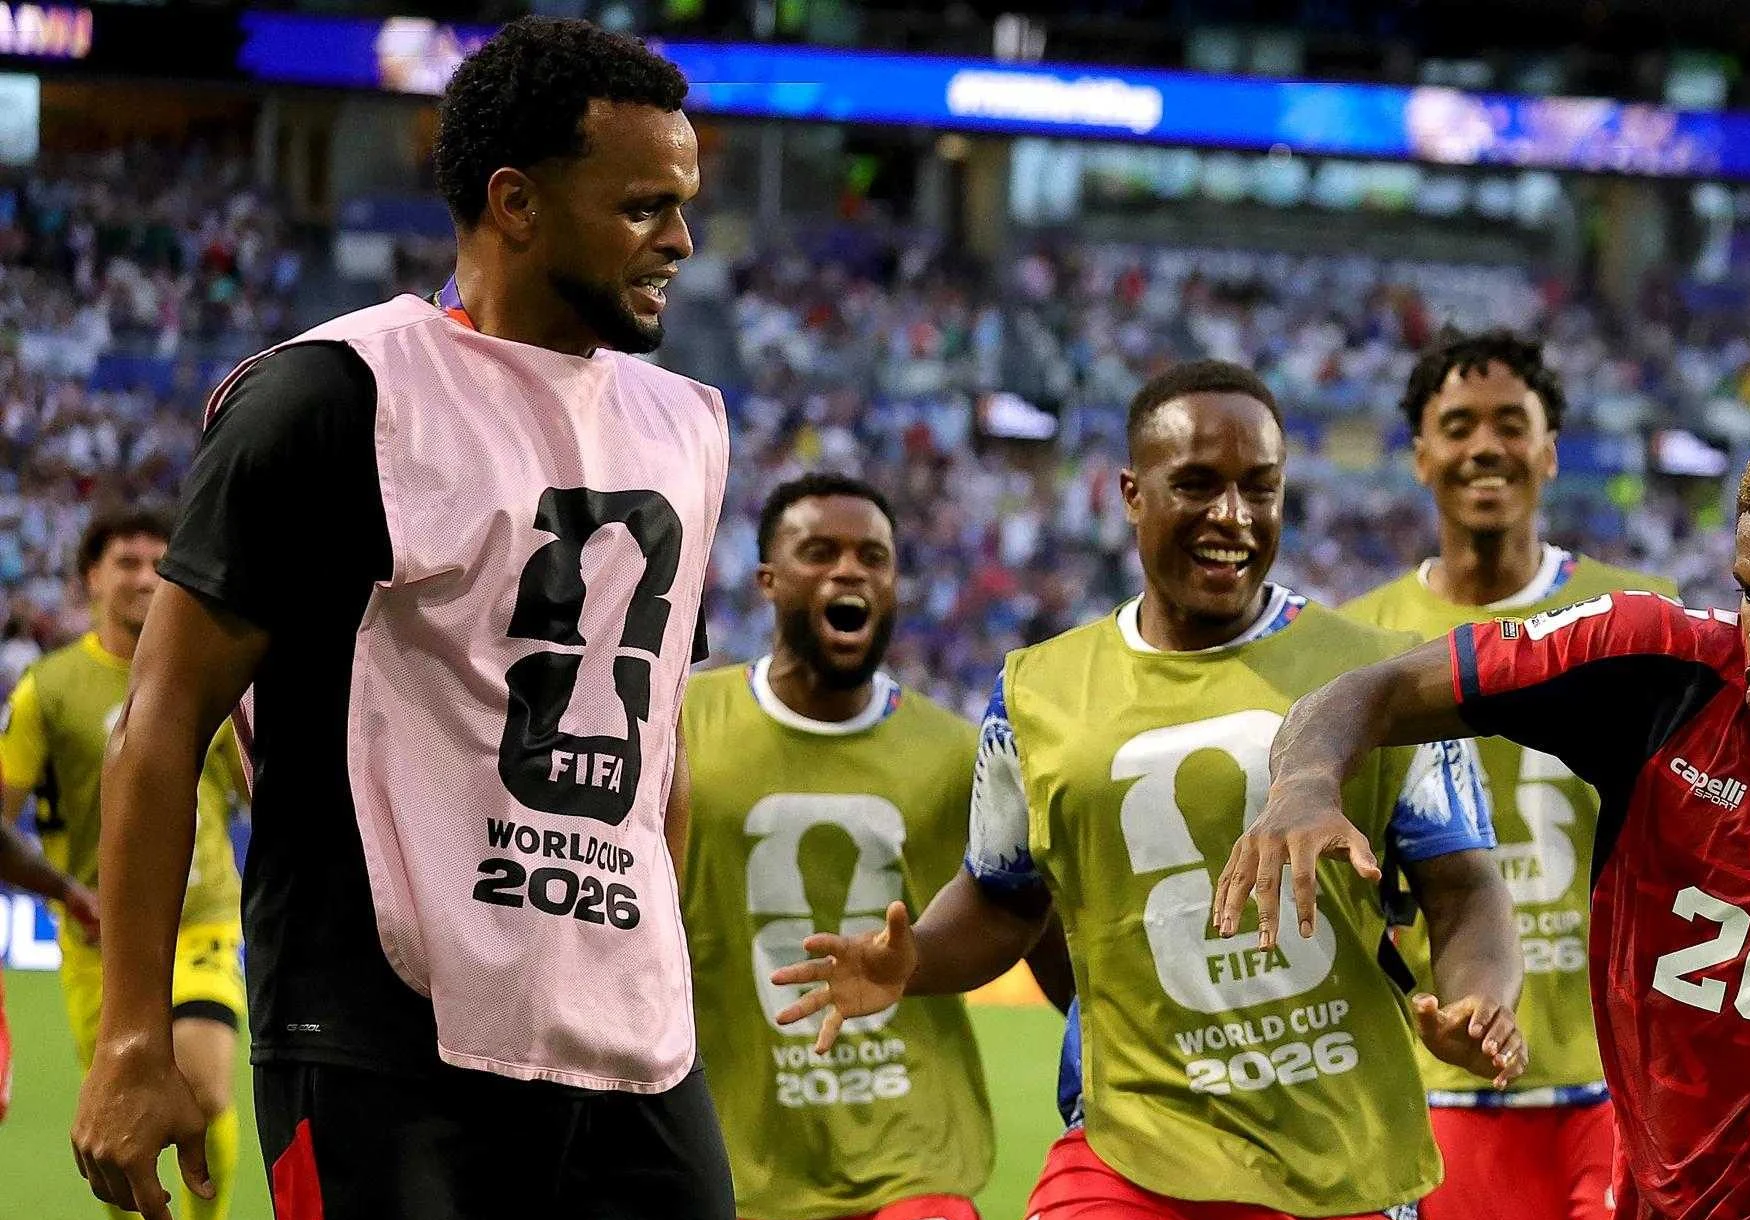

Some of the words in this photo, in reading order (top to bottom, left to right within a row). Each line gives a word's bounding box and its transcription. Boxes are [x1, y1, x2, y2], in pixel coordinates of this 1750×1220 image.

[548, 748, 624, 794] FIFA
[1670, 757, 1747, 806] capelli
[1694, 788, 1738, 812] SPORT
[1495, 856, 1541, 880] IFA
[472, 857, 641, 931] 2026
[1206, 945, 1292, 985] FIFA
[1519, 938, 1587, 973] 26
[1174, 1016, 1286, 1056] WORLD
[1289, 999, 1350, 1034] CUP
[776, 1063, 912, 1108] 2026
[1184, 1031, 1360, 1096] 2026
